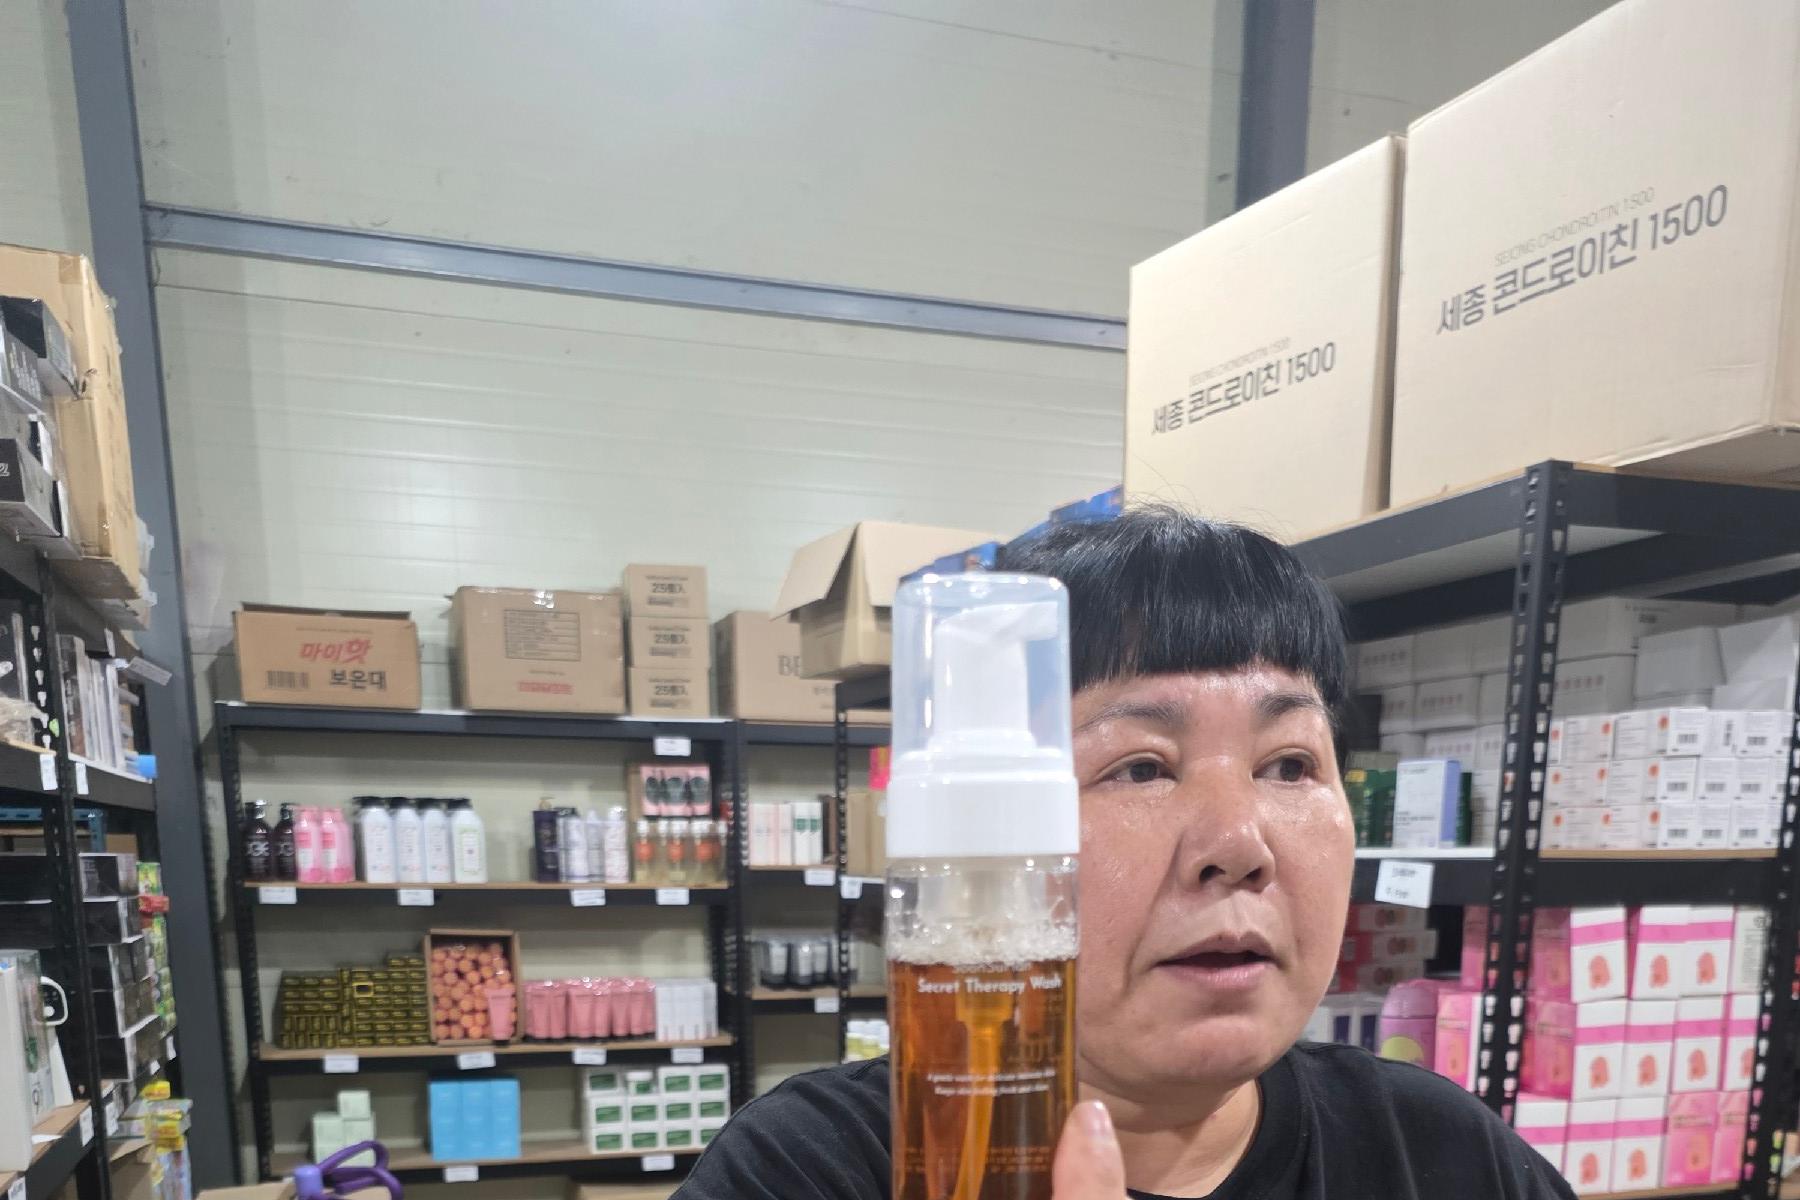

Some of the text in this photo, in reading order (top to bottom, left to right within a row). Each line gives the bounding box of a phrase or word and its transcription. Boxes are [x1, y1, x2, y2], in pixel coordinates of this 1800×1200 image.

[1436, 184, 1728, 335] 세종 콘드로이친 1500
[1151, 398, 1184, 435] 세종
[1188, 359, 1281, 424] 콘드로이친
[1286, 341, 1336, 387] 1500
[329, 668, 387, 691] 보온대
[917, 973, 1062, 996] Secret Therapy Wash
